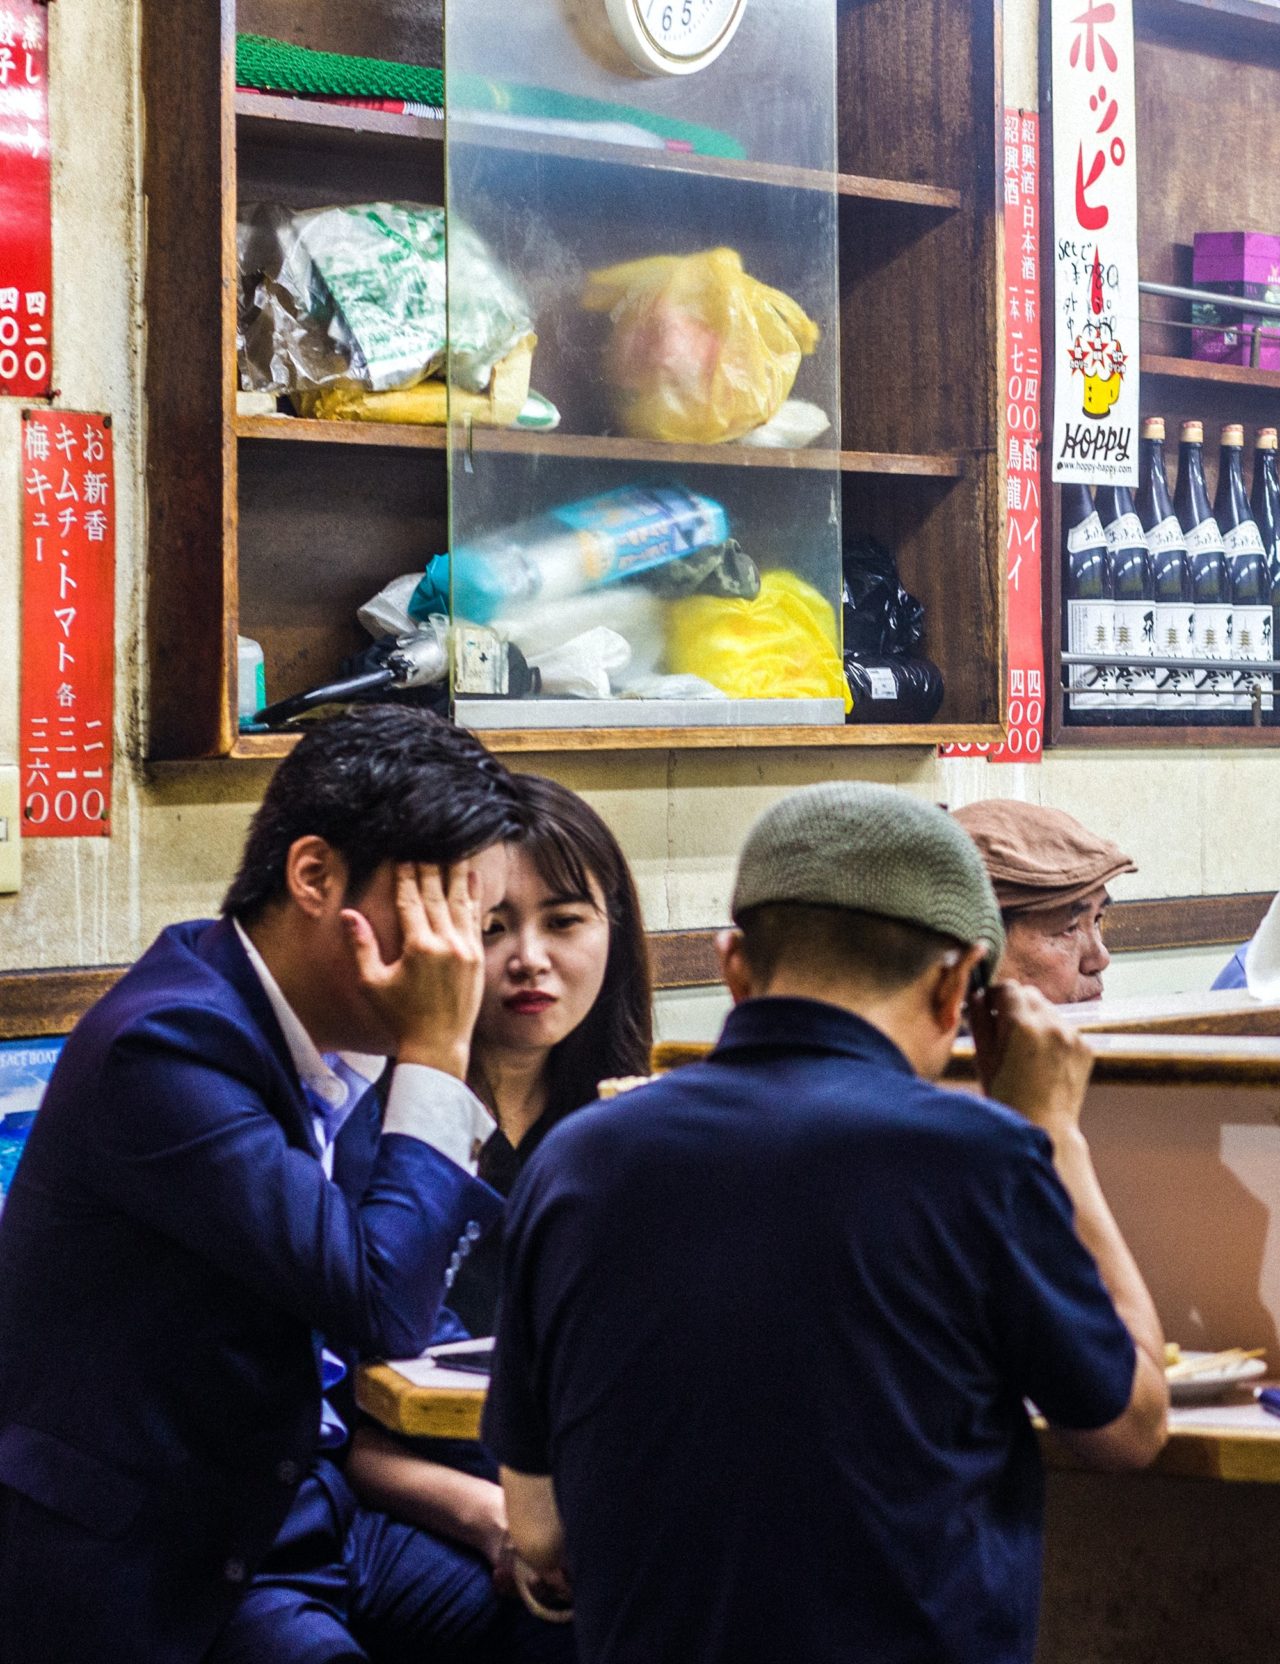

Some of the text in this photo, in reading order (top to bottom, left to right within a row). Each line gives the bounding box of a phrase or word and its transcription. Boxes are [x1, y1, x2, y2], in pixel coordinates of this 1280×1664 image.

[661, 5, 673, 32] 6
[0, 286, 19, 379] 四〇〇
[25, 291, 47, 381] 四二〇
[82, 422, 109, 542] お新香
[1057, 462, 1133, 474] ww.hoppy-happy.com
[1060, 423, 1131, 462] Hoppy
[24, 424, 53, 823] 梅キュー 三六〇
[1022, 438, 1041, 753] 酎ハイ 四〇〇
[1007, 669, 1024, 754] 四〇〇
